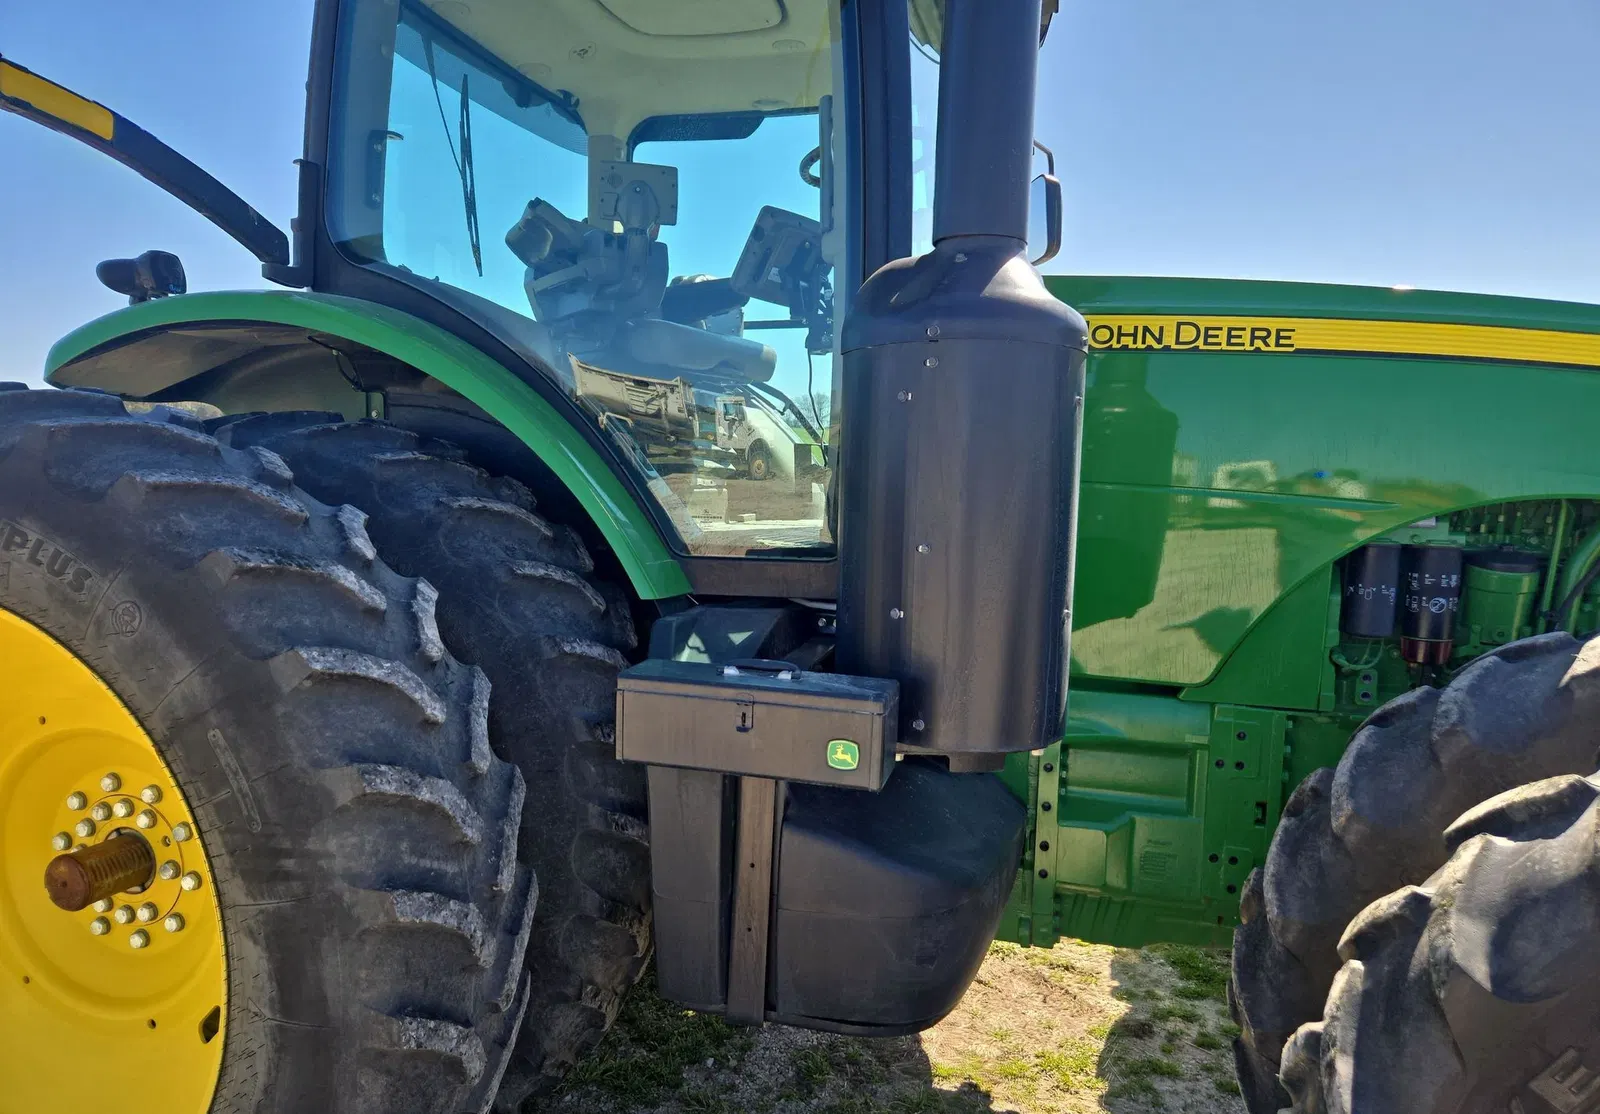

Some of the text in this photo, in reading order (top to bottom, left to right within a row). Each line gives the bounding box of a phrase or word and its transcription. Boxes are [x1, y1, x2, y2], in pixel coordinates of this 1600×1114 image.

[1087, 321, 1296, 348] OHN DEERE
[2, 525, 94, 593] PLUS
